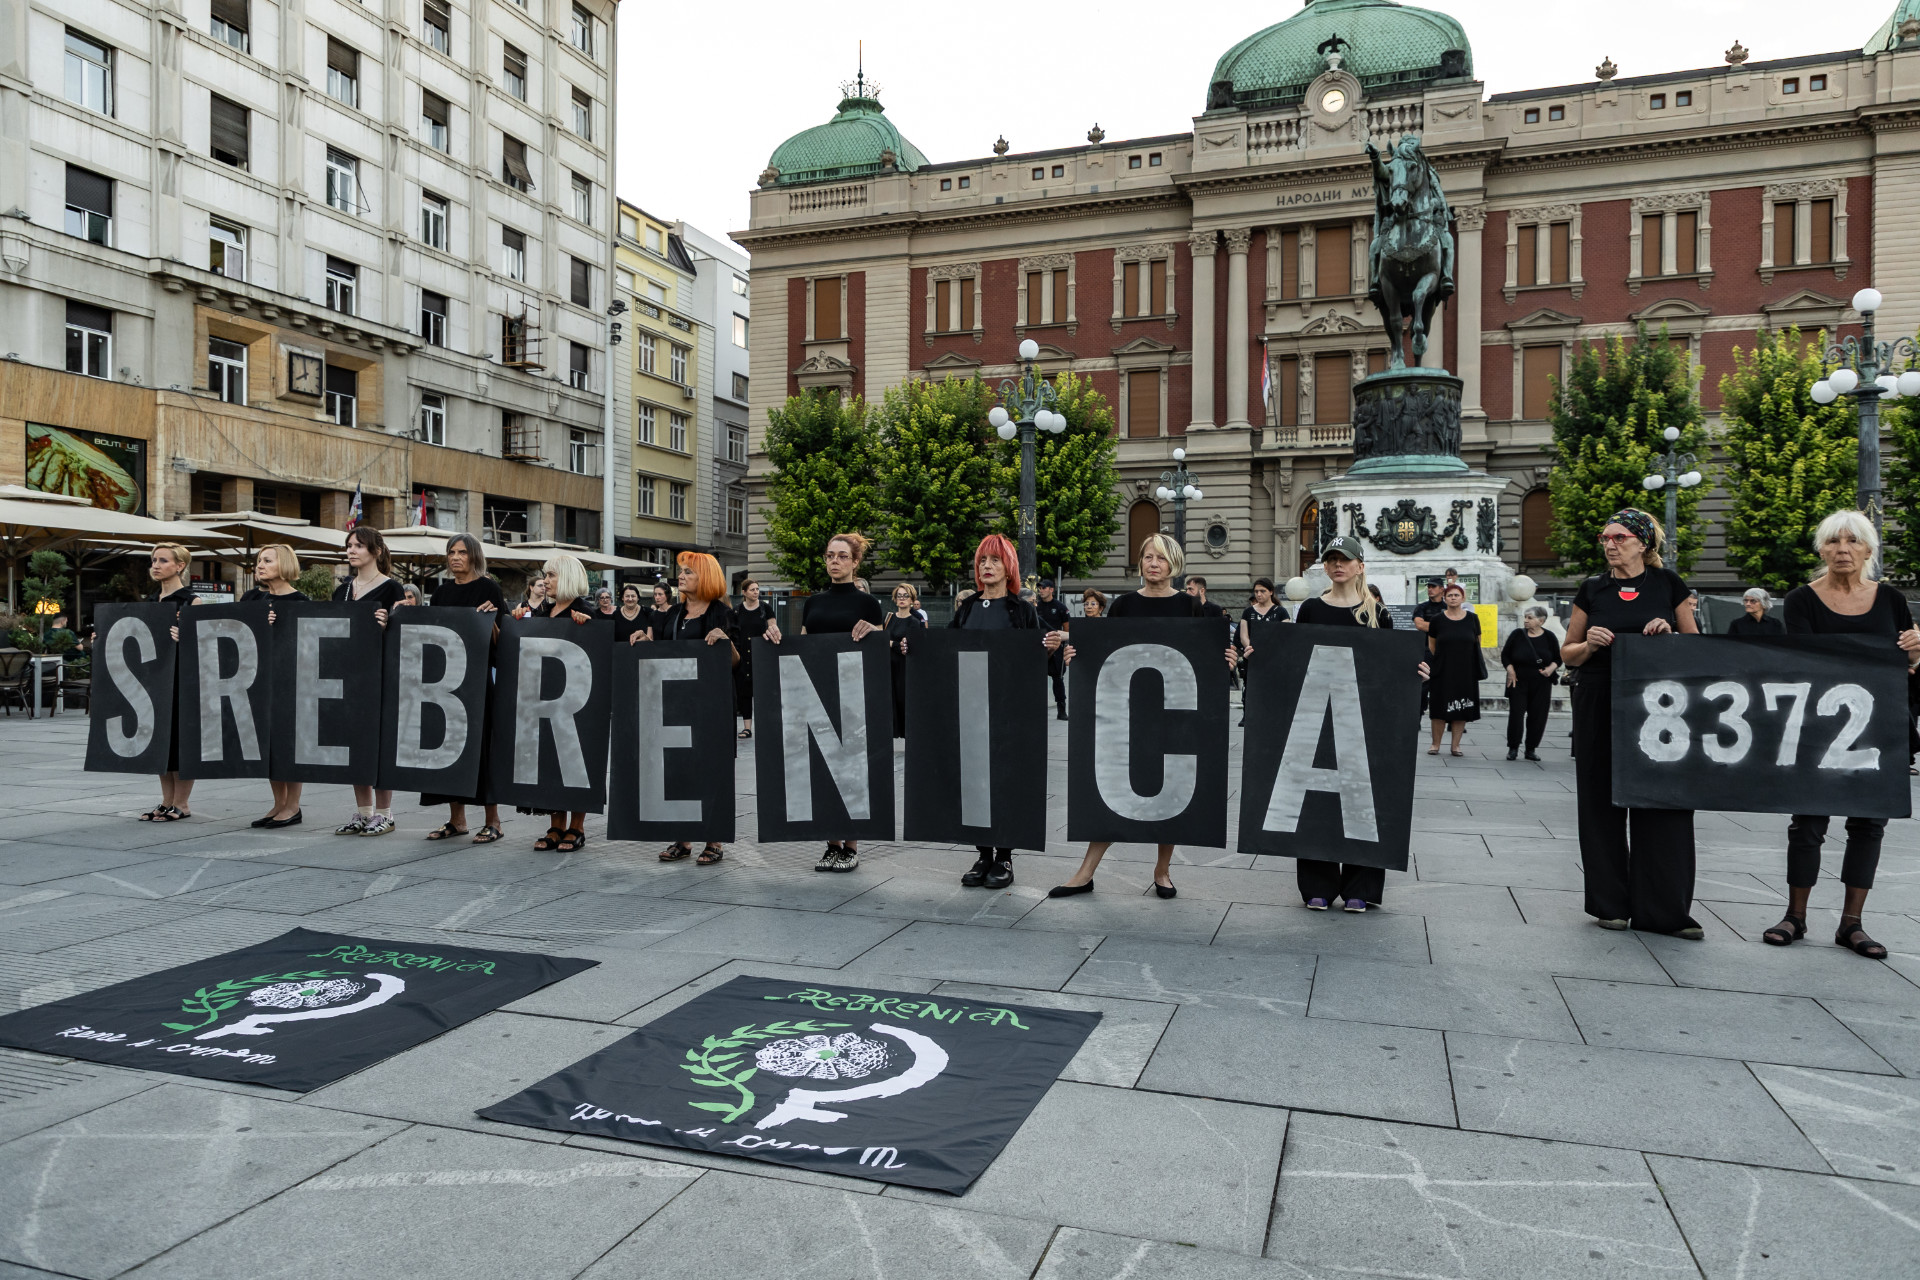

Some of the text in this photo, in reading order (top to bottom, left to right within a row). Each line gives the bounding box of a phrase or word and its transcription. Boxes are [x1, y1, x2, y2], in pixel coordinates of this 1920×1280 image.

[1276, 189, 1342, 206] НАРОДНИ
[94, 437, 139, 450] BOUTIQUE
[103, 615, 1380, 844] SREBRENICA
[1637, 680, 1881, 771] 8372
